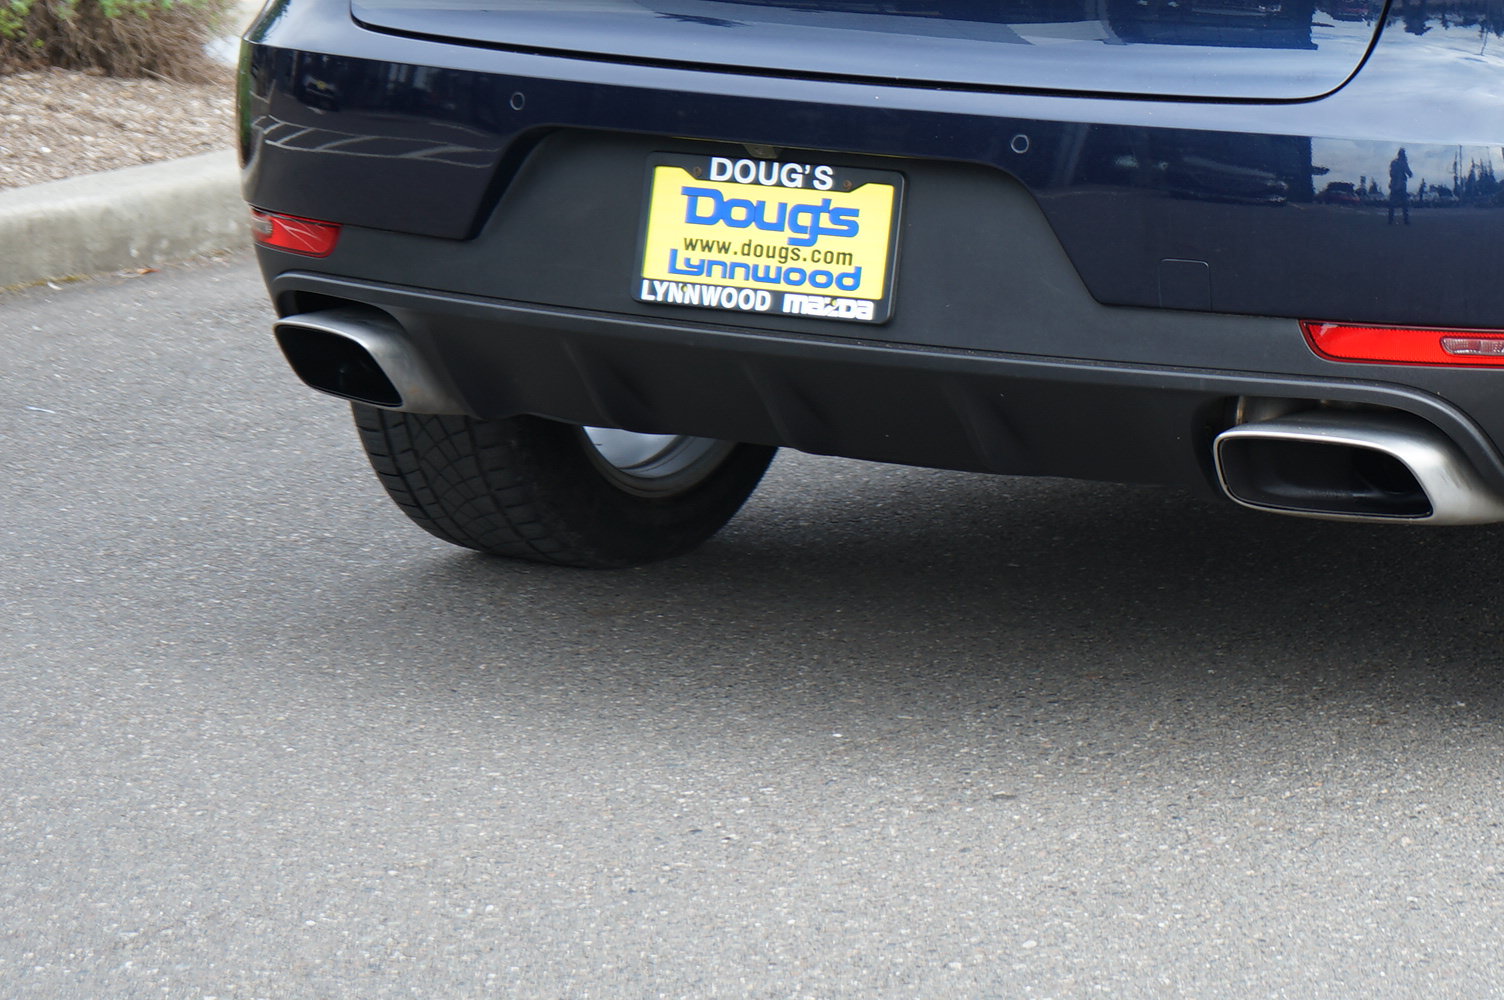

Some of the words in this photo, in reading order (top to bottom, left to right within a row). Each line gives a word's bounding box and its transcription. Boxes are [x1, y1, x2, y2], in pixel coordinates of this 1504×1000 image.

[709, 156, 834, 191] DOUG'S
[680, 185, 860, 248] Doug's
[683, 236, 854, 267] www.dougs.com
[667, 248, 863, 292] Lynnwood
[640, 279, 772, 312] LYNNWOOD
